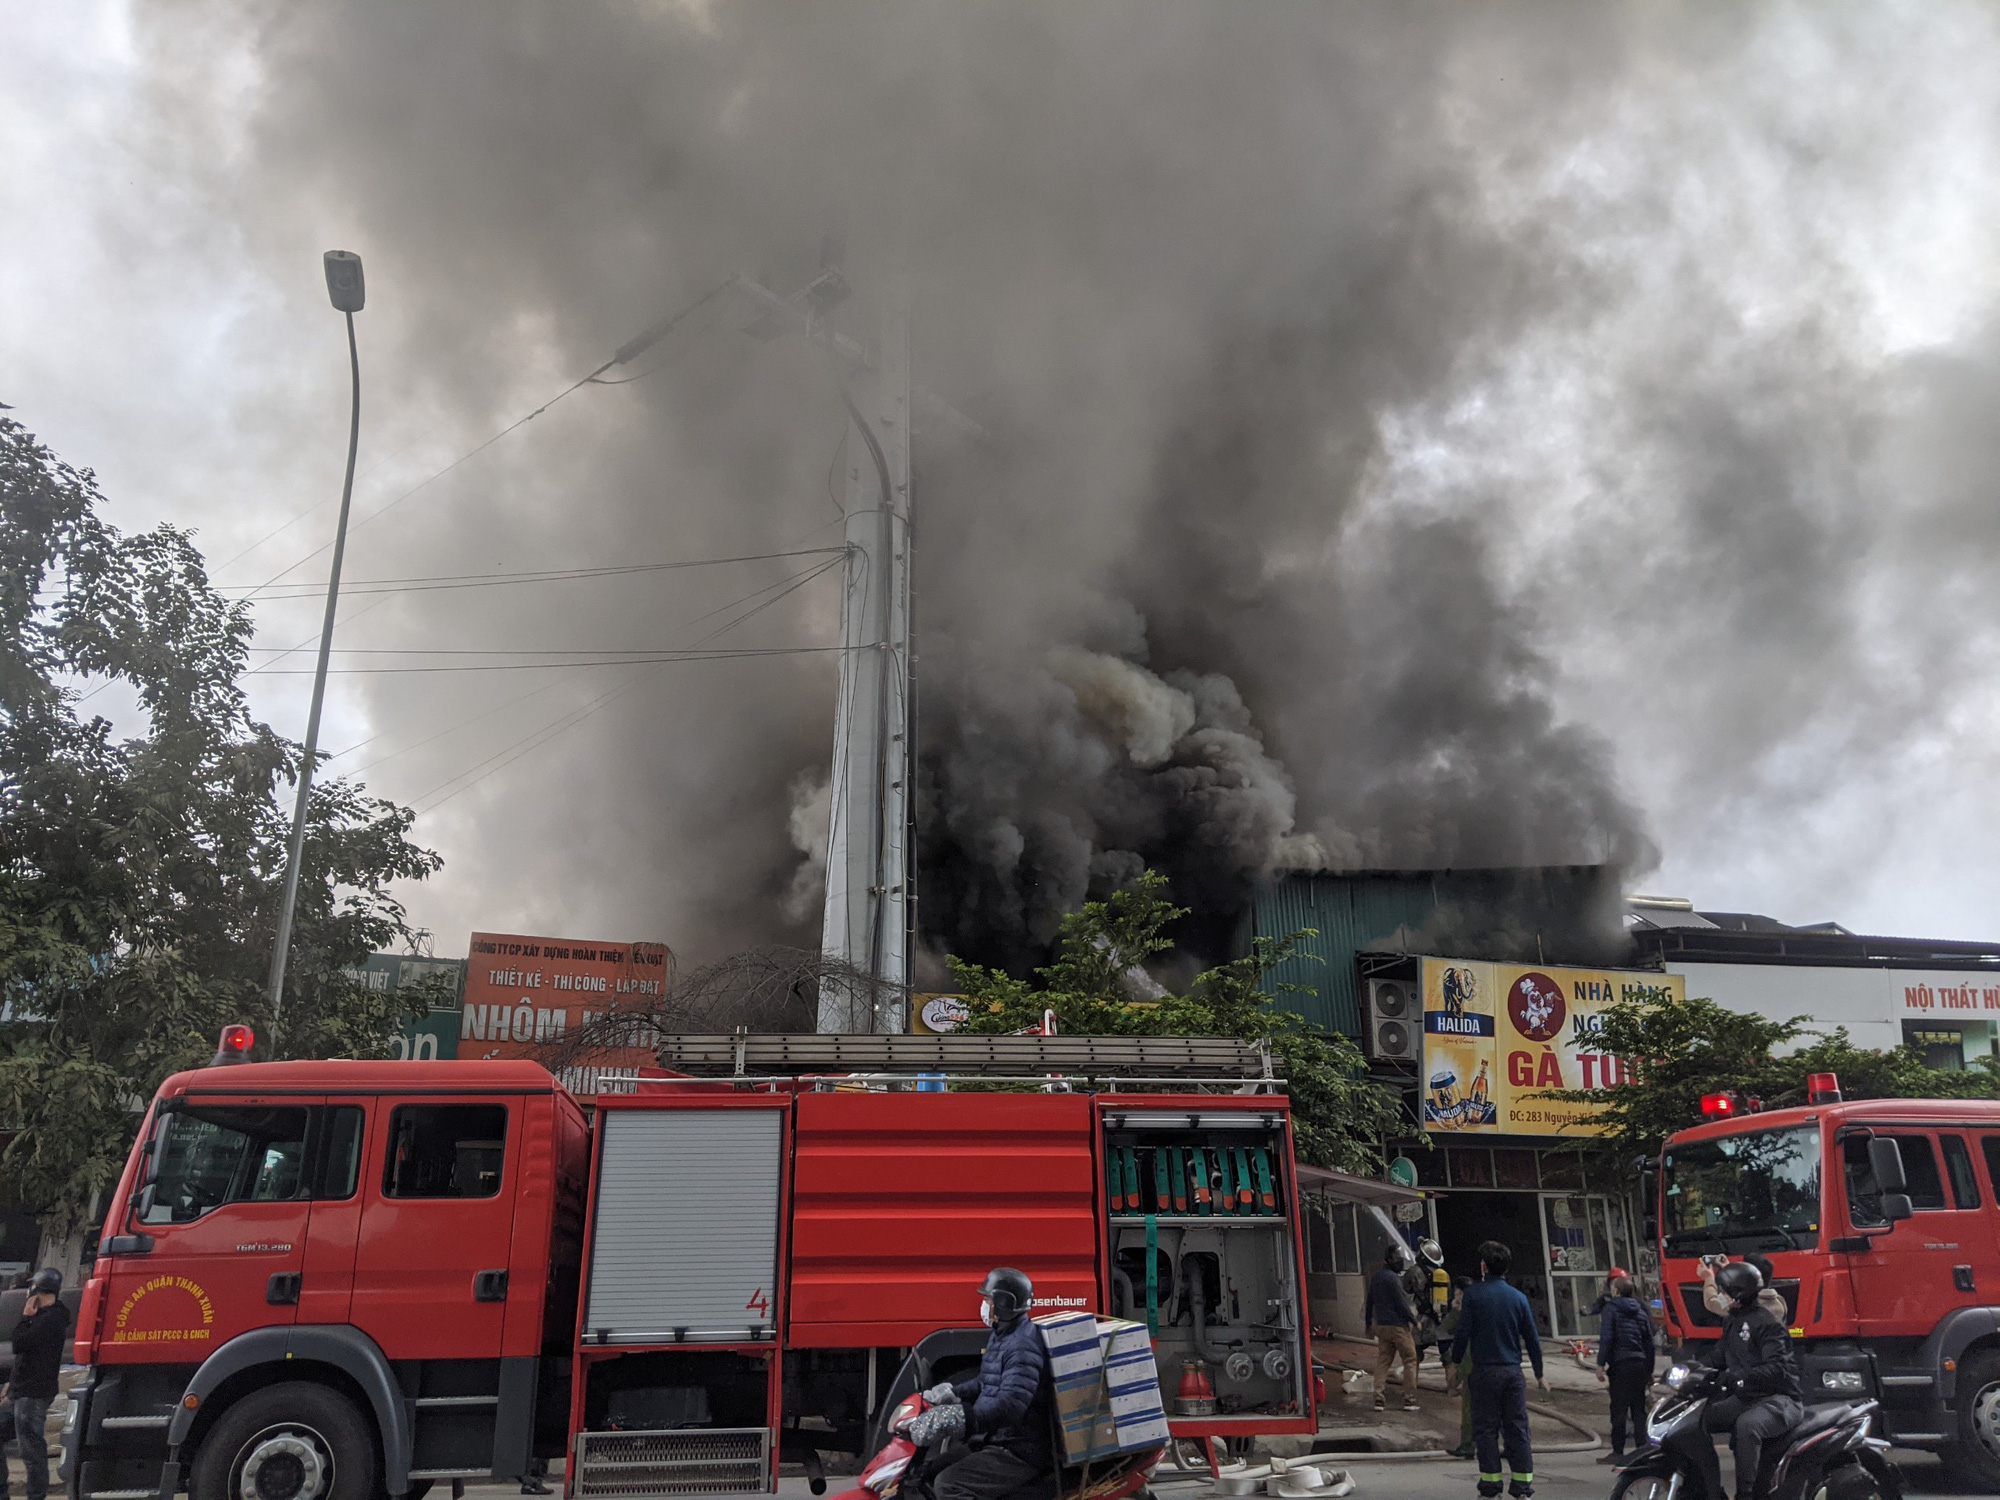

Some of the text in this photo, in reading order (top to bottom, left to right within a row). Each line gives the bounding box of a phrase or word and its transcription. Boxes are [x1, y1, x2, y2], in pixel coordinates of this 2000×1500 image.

[497, 943, 508, 954] TY
[509, 944, 522, 955] CP
[572, 947, 596, 961] HOÀN
[525, 966, 544, 988] KẾ
[574, 972, 607, 992] CÔNG
[1574, 979, 1673, 1005] NHÀ HÀNG
[1904, 983, 1935, 1012] NỘI
[1938, 981, 1978, 1009] THẤT
[461, 997, 567, 1044] NHÔM
[1437, 1016, 1481, 1034] HALIDA
[1507, 1044, 1565, 1088] GÀ
[1509, 1110, 1525, 1122] ĐC:
[1526, 1111, 1542, 1123] 283
[116, 1275, 215, 1328] CÔNG AN QUẬN THANH XUÂN
[746, 1287, 770, 1319] 4
[1031, 1295, 1088, 1307] osenbauer
[162, 1330, 182, 1340] PCCC
[183, 1330, 189, 1339] &
